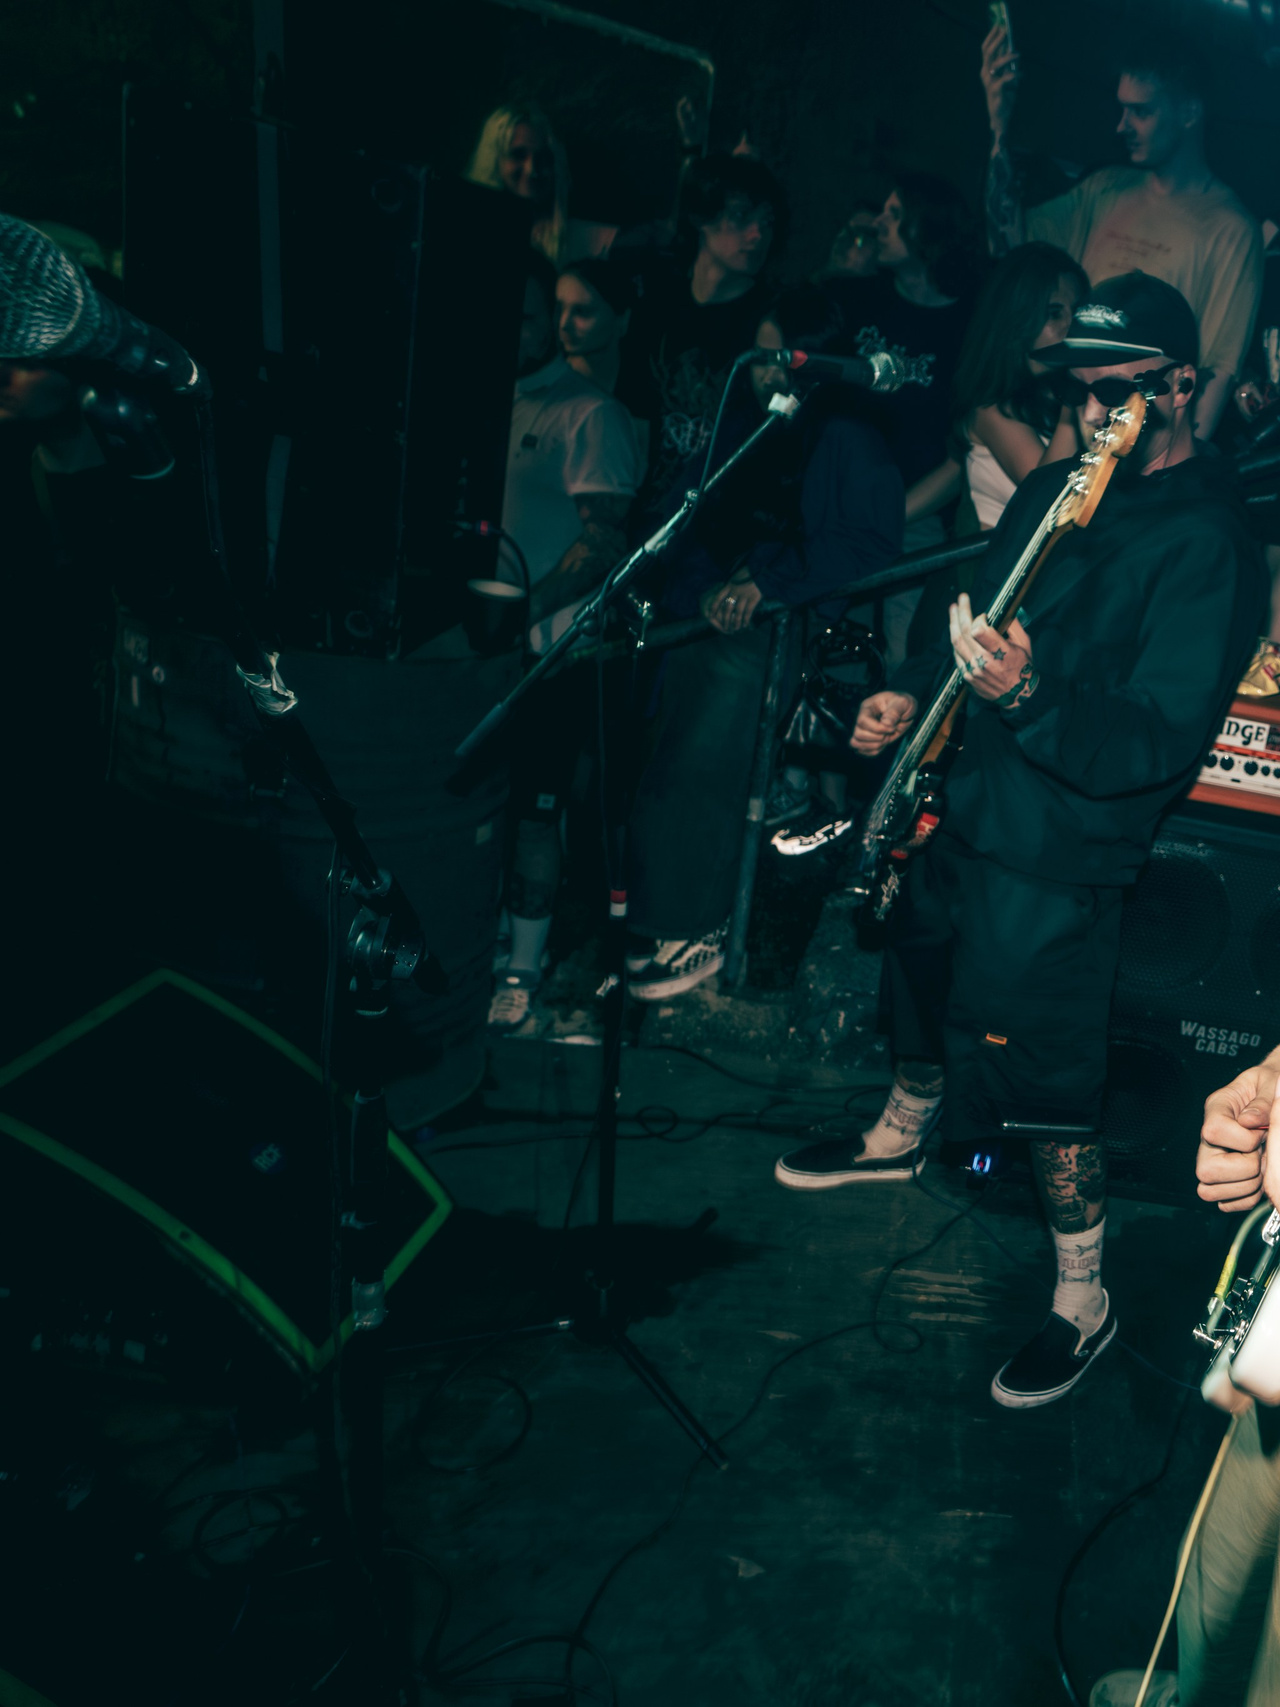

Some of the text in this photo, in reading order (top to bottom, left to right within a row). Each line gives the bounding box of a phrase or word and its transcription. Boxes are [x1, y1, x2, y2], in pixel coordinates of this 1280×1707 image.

[1226, 720, 1266, 746] NGE
[1181, 1019, 1261, 1048] WASSAGO
[1195, 1038, 1239, 1057] CABS
